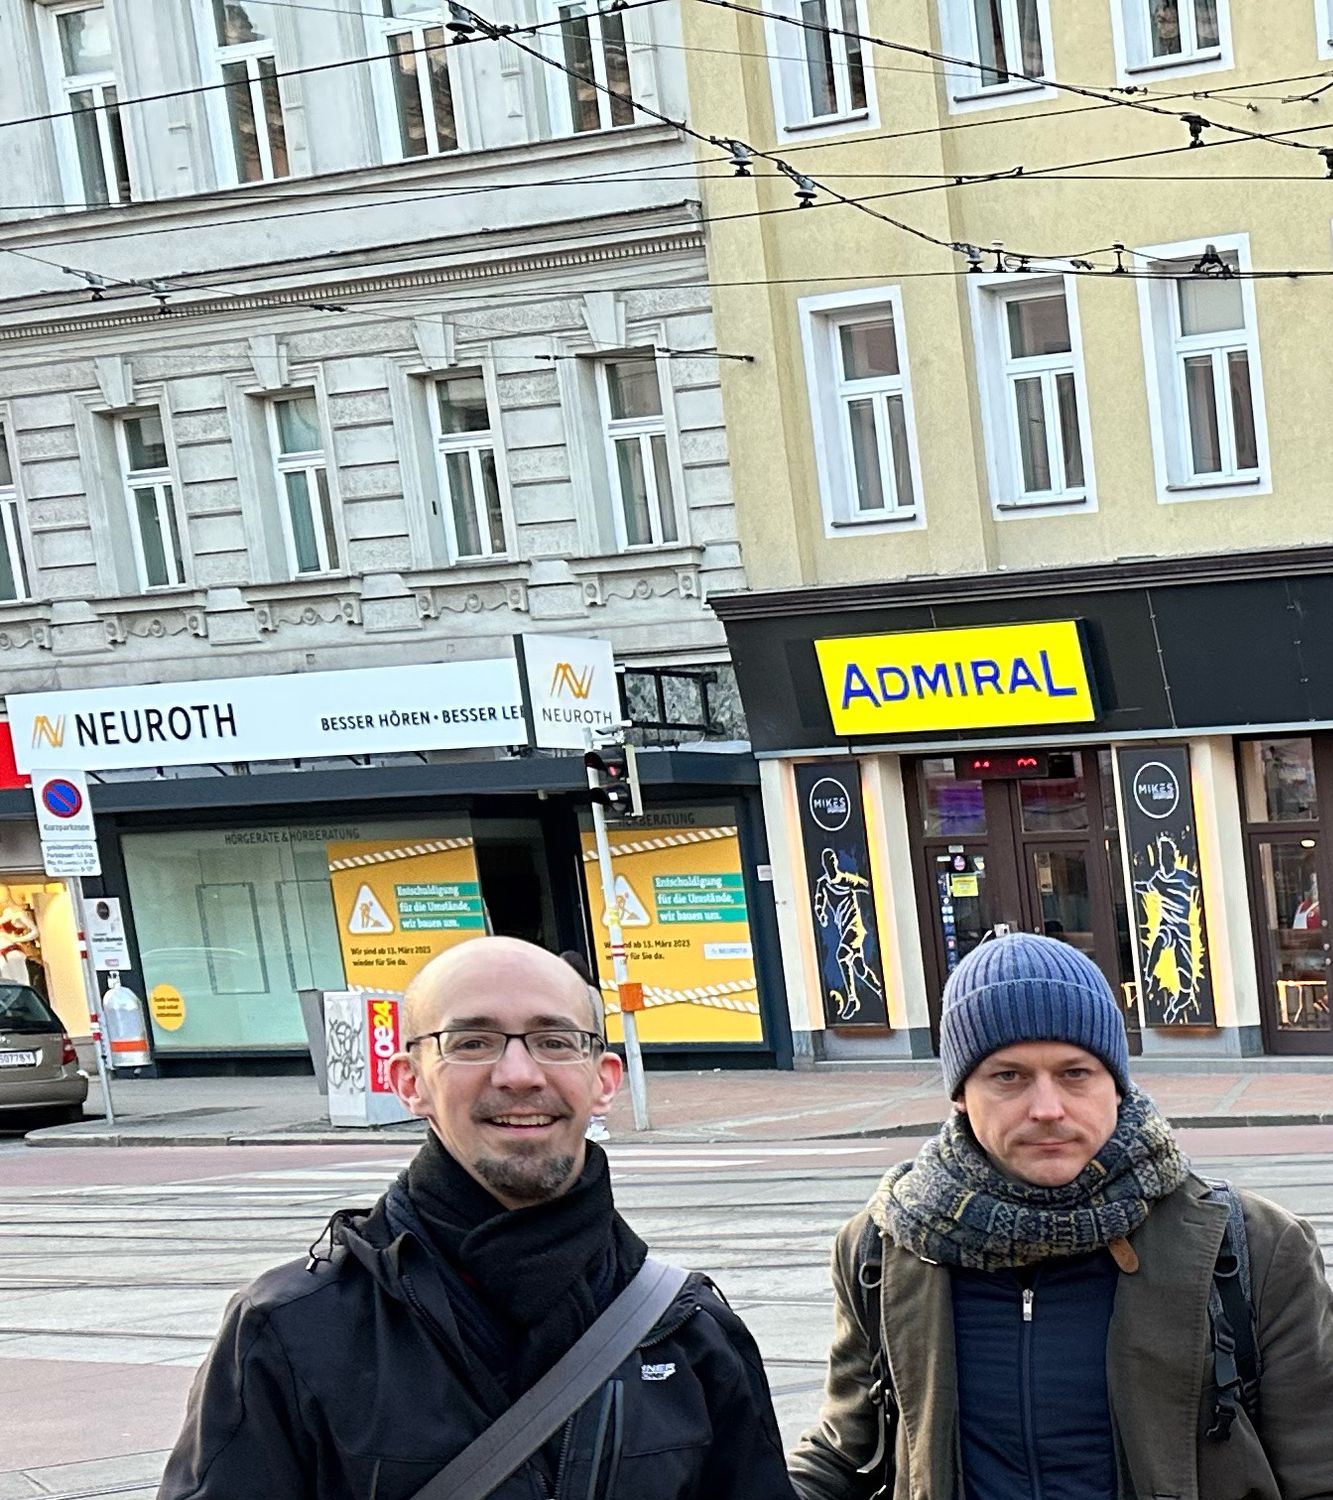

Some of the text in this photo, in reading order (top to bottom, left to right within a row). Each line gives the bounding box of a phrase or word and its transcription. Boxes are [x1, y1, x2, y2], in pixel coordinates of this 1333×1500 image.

[842, 650, 1077, 710] ADMIRAL
[320, 705, 525, 732] BESSER HÖREN BESSER LE
[542, 707, 613, 725] NEUROTH
[75, 702, 238, 748] NEUROTH
[1138, 782, 1174, 795] MIKES
[813, 797, 846, 808] MIKES
[655, 876, 723, 889] Entschuldigung
[397, 885, 459, 898] Entschuldigung
[657, 892, 734, 905] für die Umstände,
[400, 900, 471, 913] für die Umstände,
[660, 910, 722, 922] wir bauen um.
[402, 918, 460, 929] wir bauen um.
[363, 947, 376, 955] sind
[378, 947, 387, 955] ab
[398, 946, 414, 955] März
[633, 941, 642, 949] ab
[654, 940, 672, 948] März
[352, 959, 374, 967] wieder
[375, 958, 385, 966] für
[386, 958, 396, 966] Sie
[630, 952, 641, 960] für
[642, 952, 652, 960] Sie
